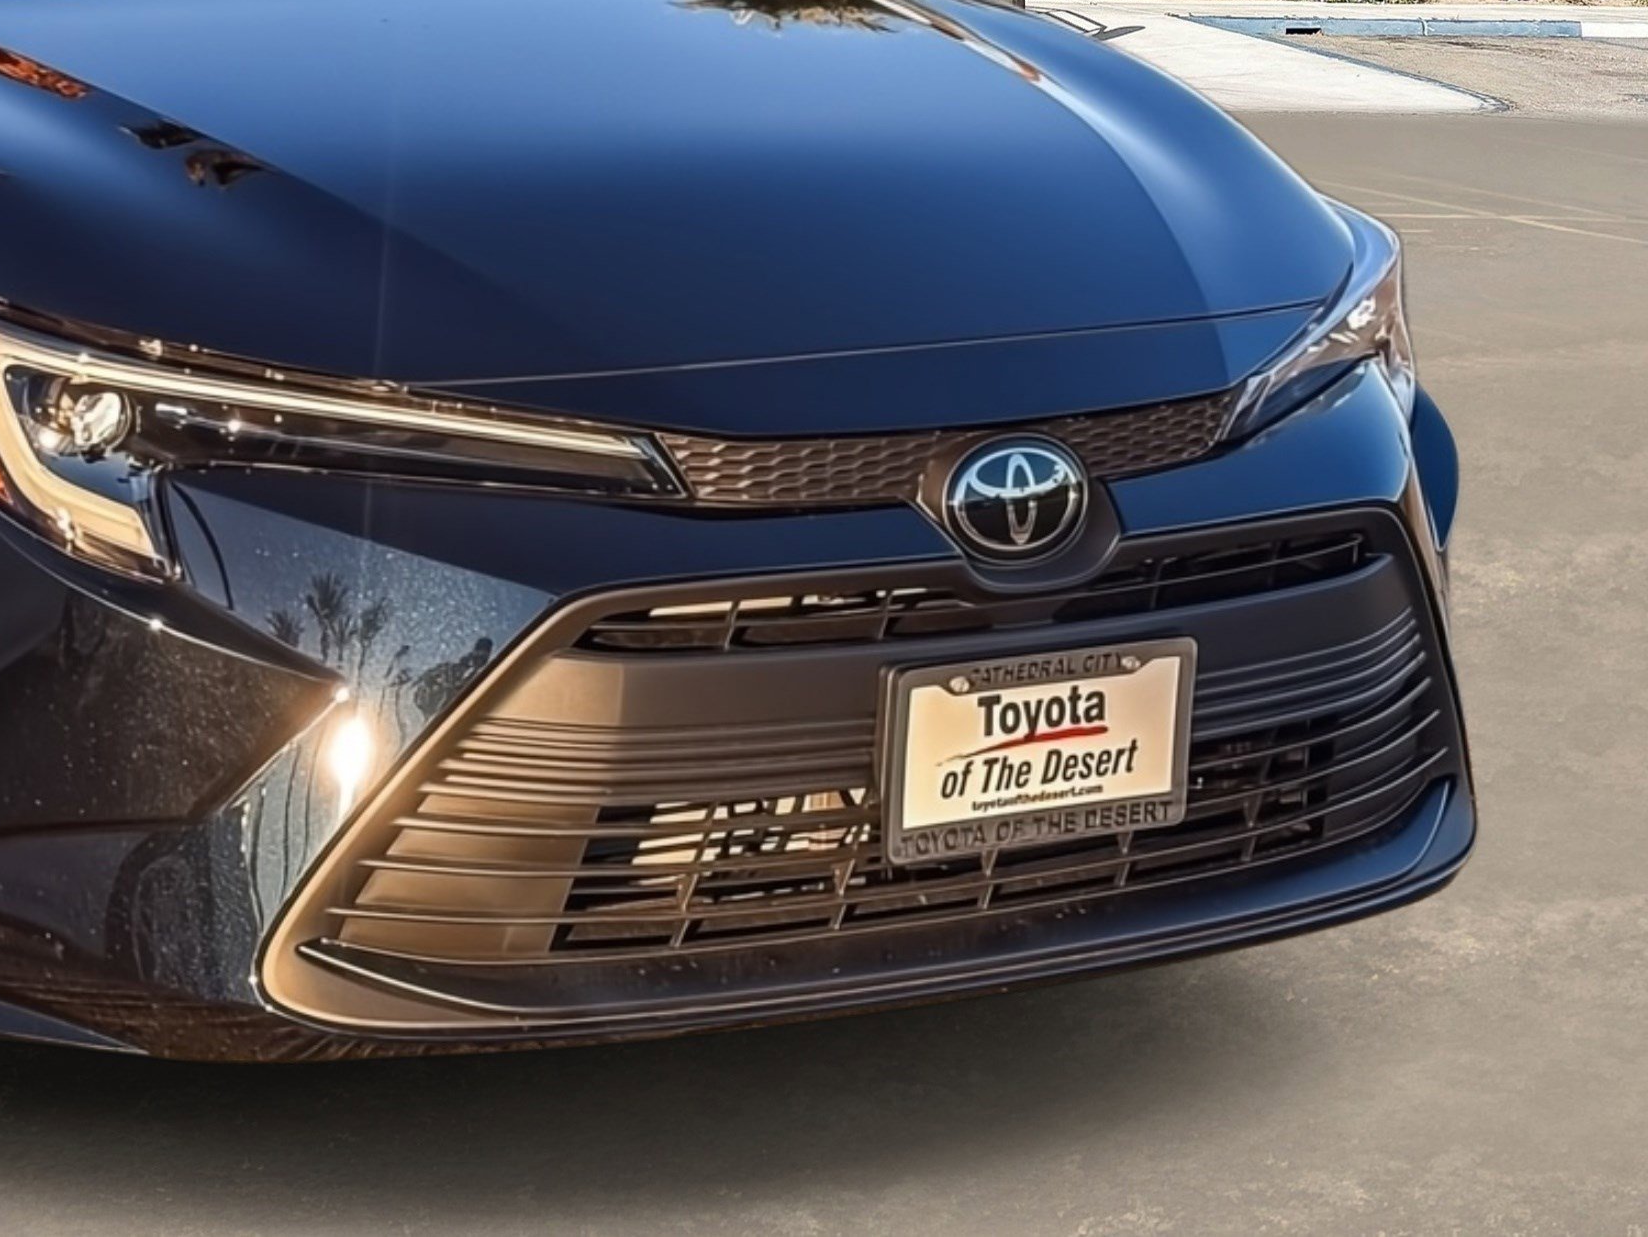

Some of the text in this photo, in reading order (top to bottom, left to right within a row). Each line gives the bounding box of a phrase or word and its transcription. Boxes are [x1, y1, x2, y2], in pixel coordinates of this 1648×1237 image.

[977, 685, 1107, 739] Toyota
[940, 739, 1138, 799] of The Desert
[901, 801, 1174, 857] TOYOTA OF THE DESERT
